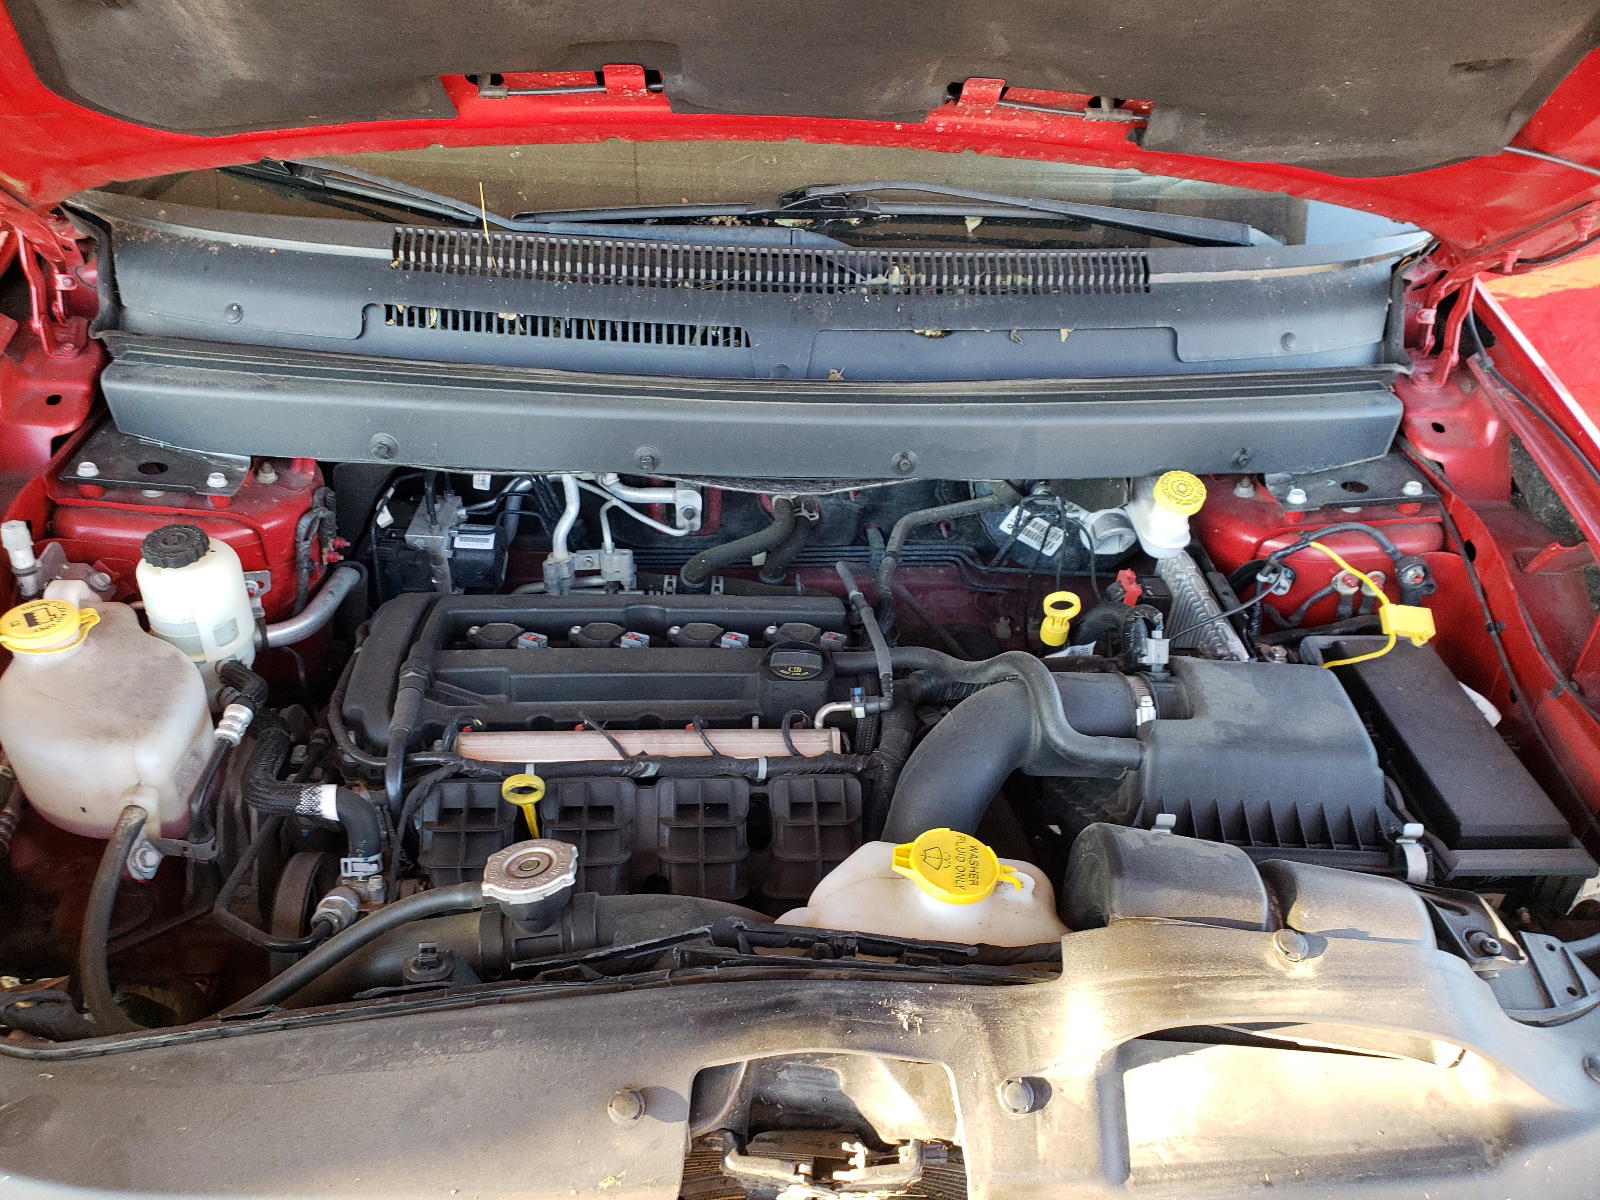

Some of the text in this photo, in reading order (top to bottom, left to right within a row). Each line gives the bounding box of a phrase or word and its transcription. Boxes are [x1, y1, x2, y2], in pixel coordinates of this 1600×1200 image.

[955, 835, 966, 891] FLUID ONLY
[968, 845, 979, 886] WASHER
